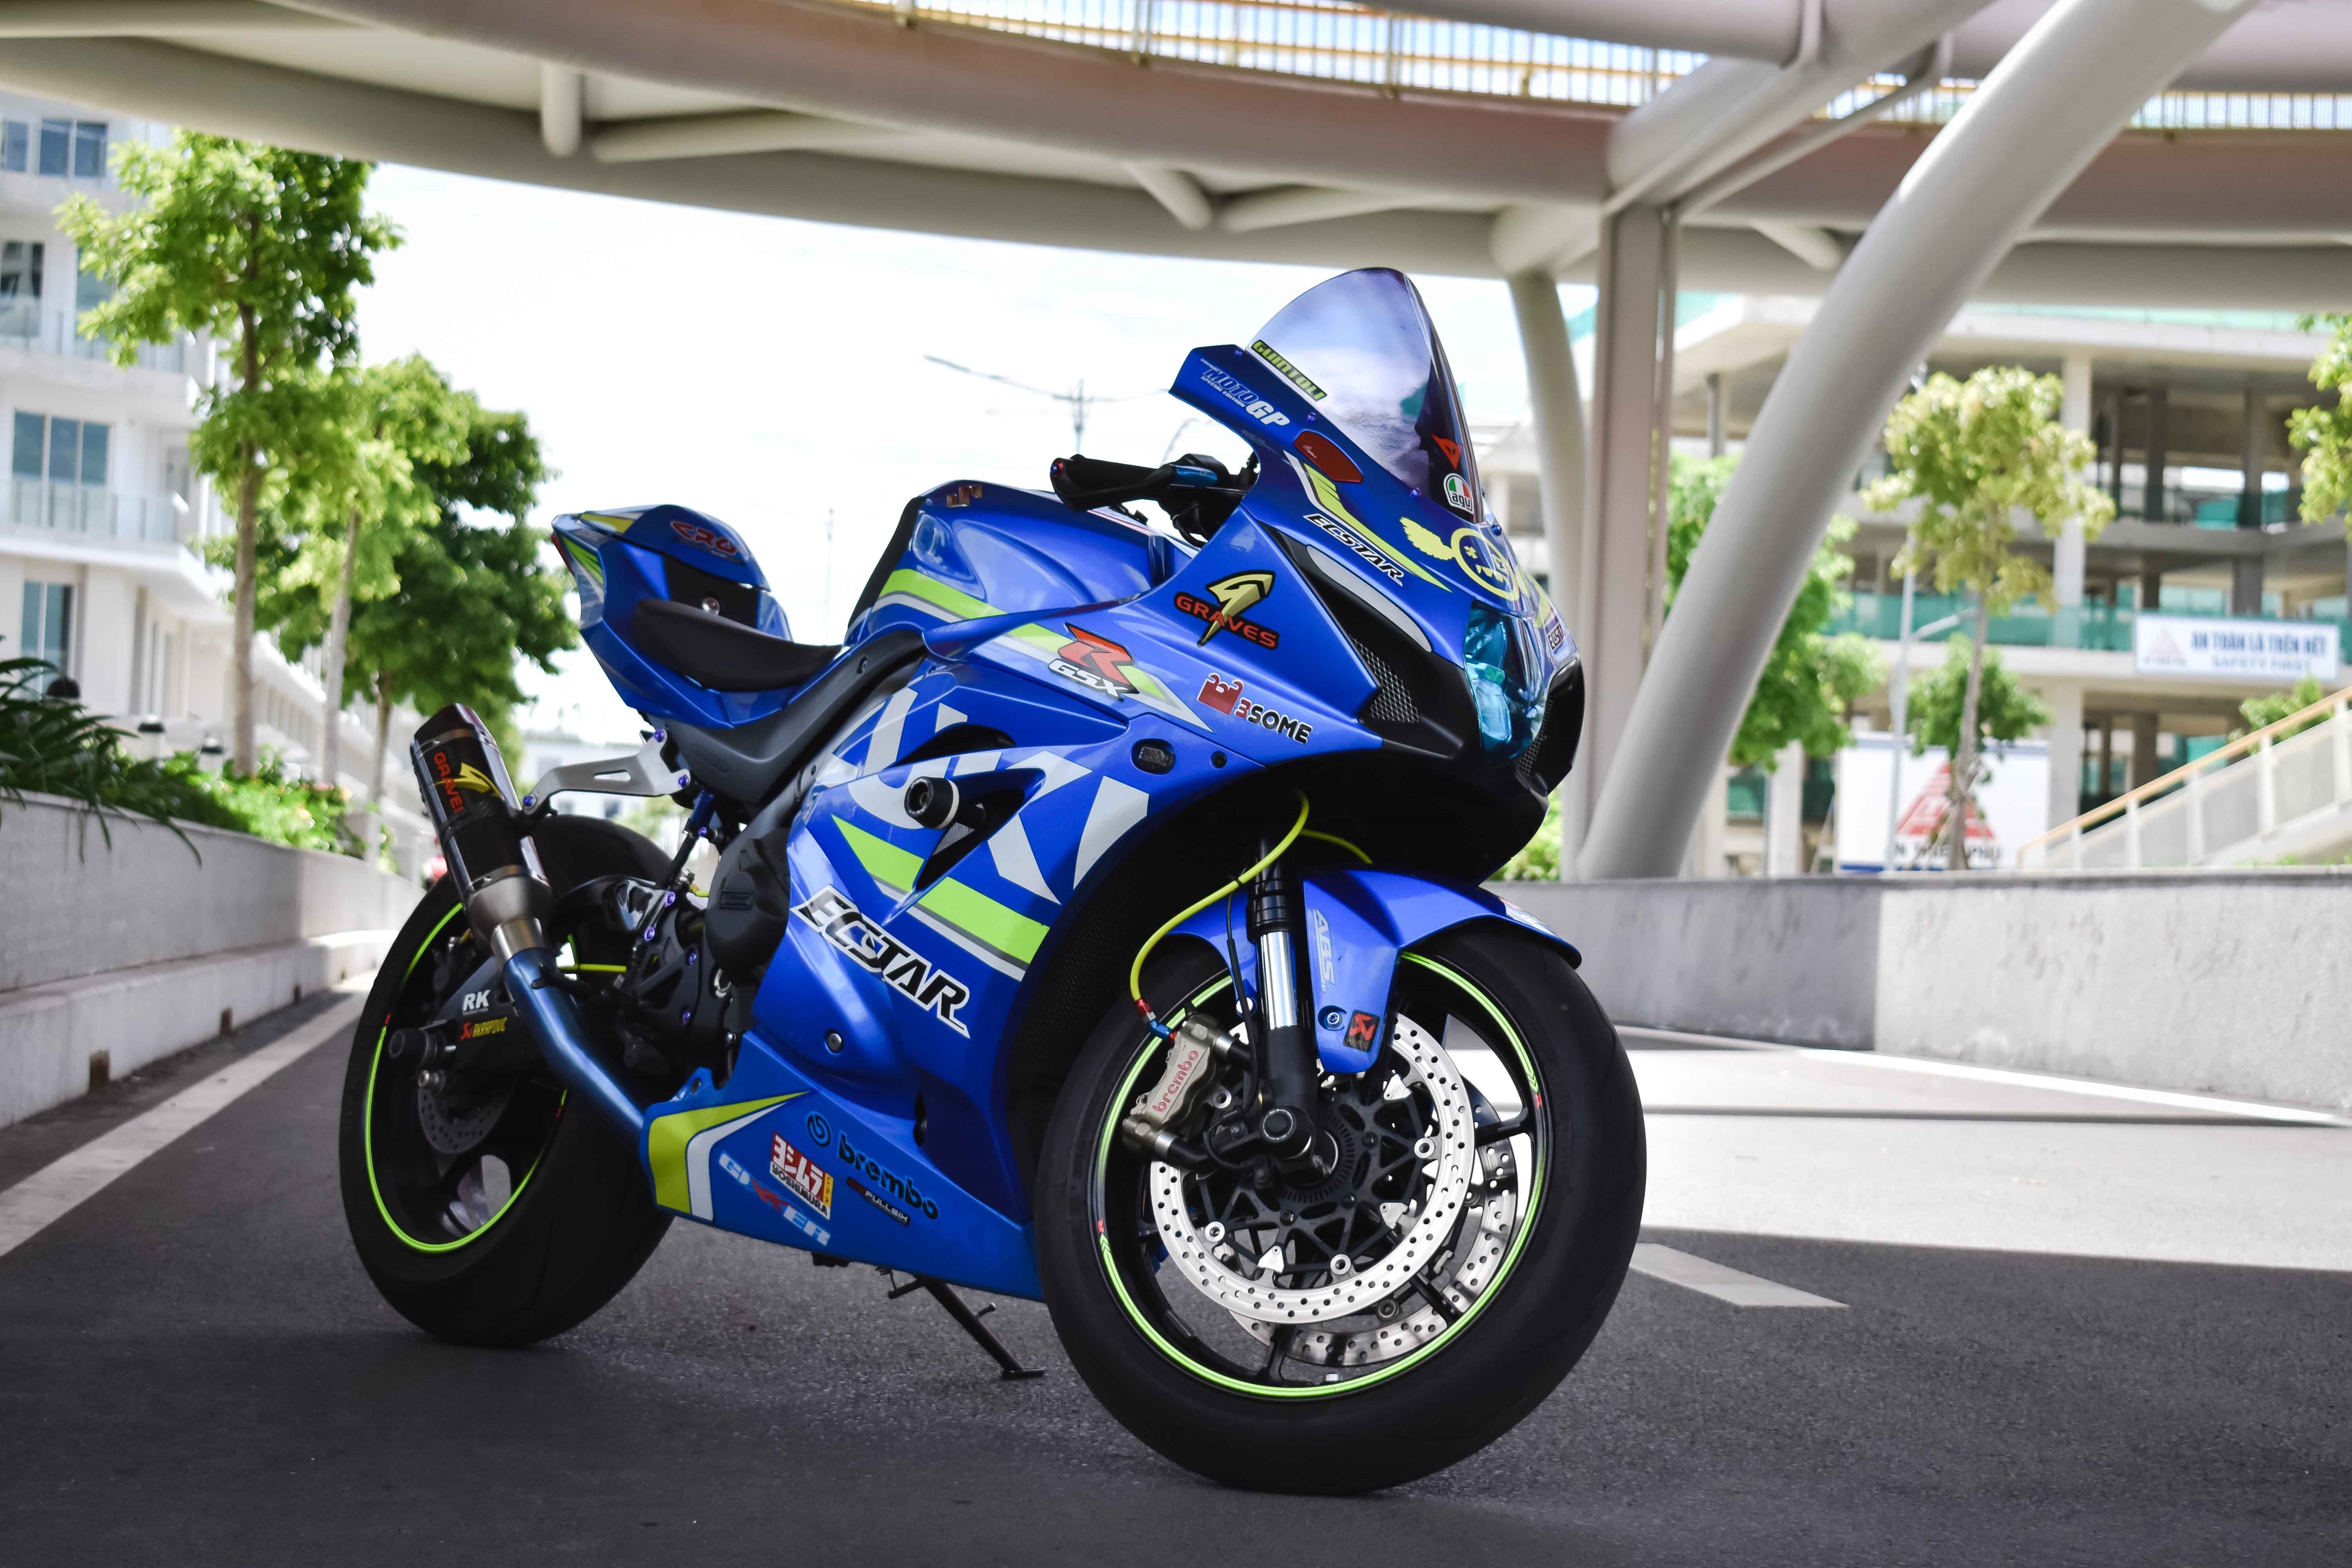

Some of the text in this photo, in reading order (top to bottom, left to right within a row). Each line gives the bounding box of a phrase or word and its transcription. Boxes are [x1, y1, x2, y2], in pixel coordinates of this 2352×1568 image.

[1253, 341, 1325, 399] GUINTOLI
[1303, 513, 1403, 586] ECSTAR
[1176, 595, 1277, 647] GRAVES
[1049, 659, 1129, 697] GSX
[790, 884, 971, 1038] ECSTAR
[463, 989, 491, 1011] RK
[772, 1163, 828, 1215] YOSHIMURA
[773, 1134, 823, 1196] ヨシムラ
[838, 1130, 939, 1220] brembo
